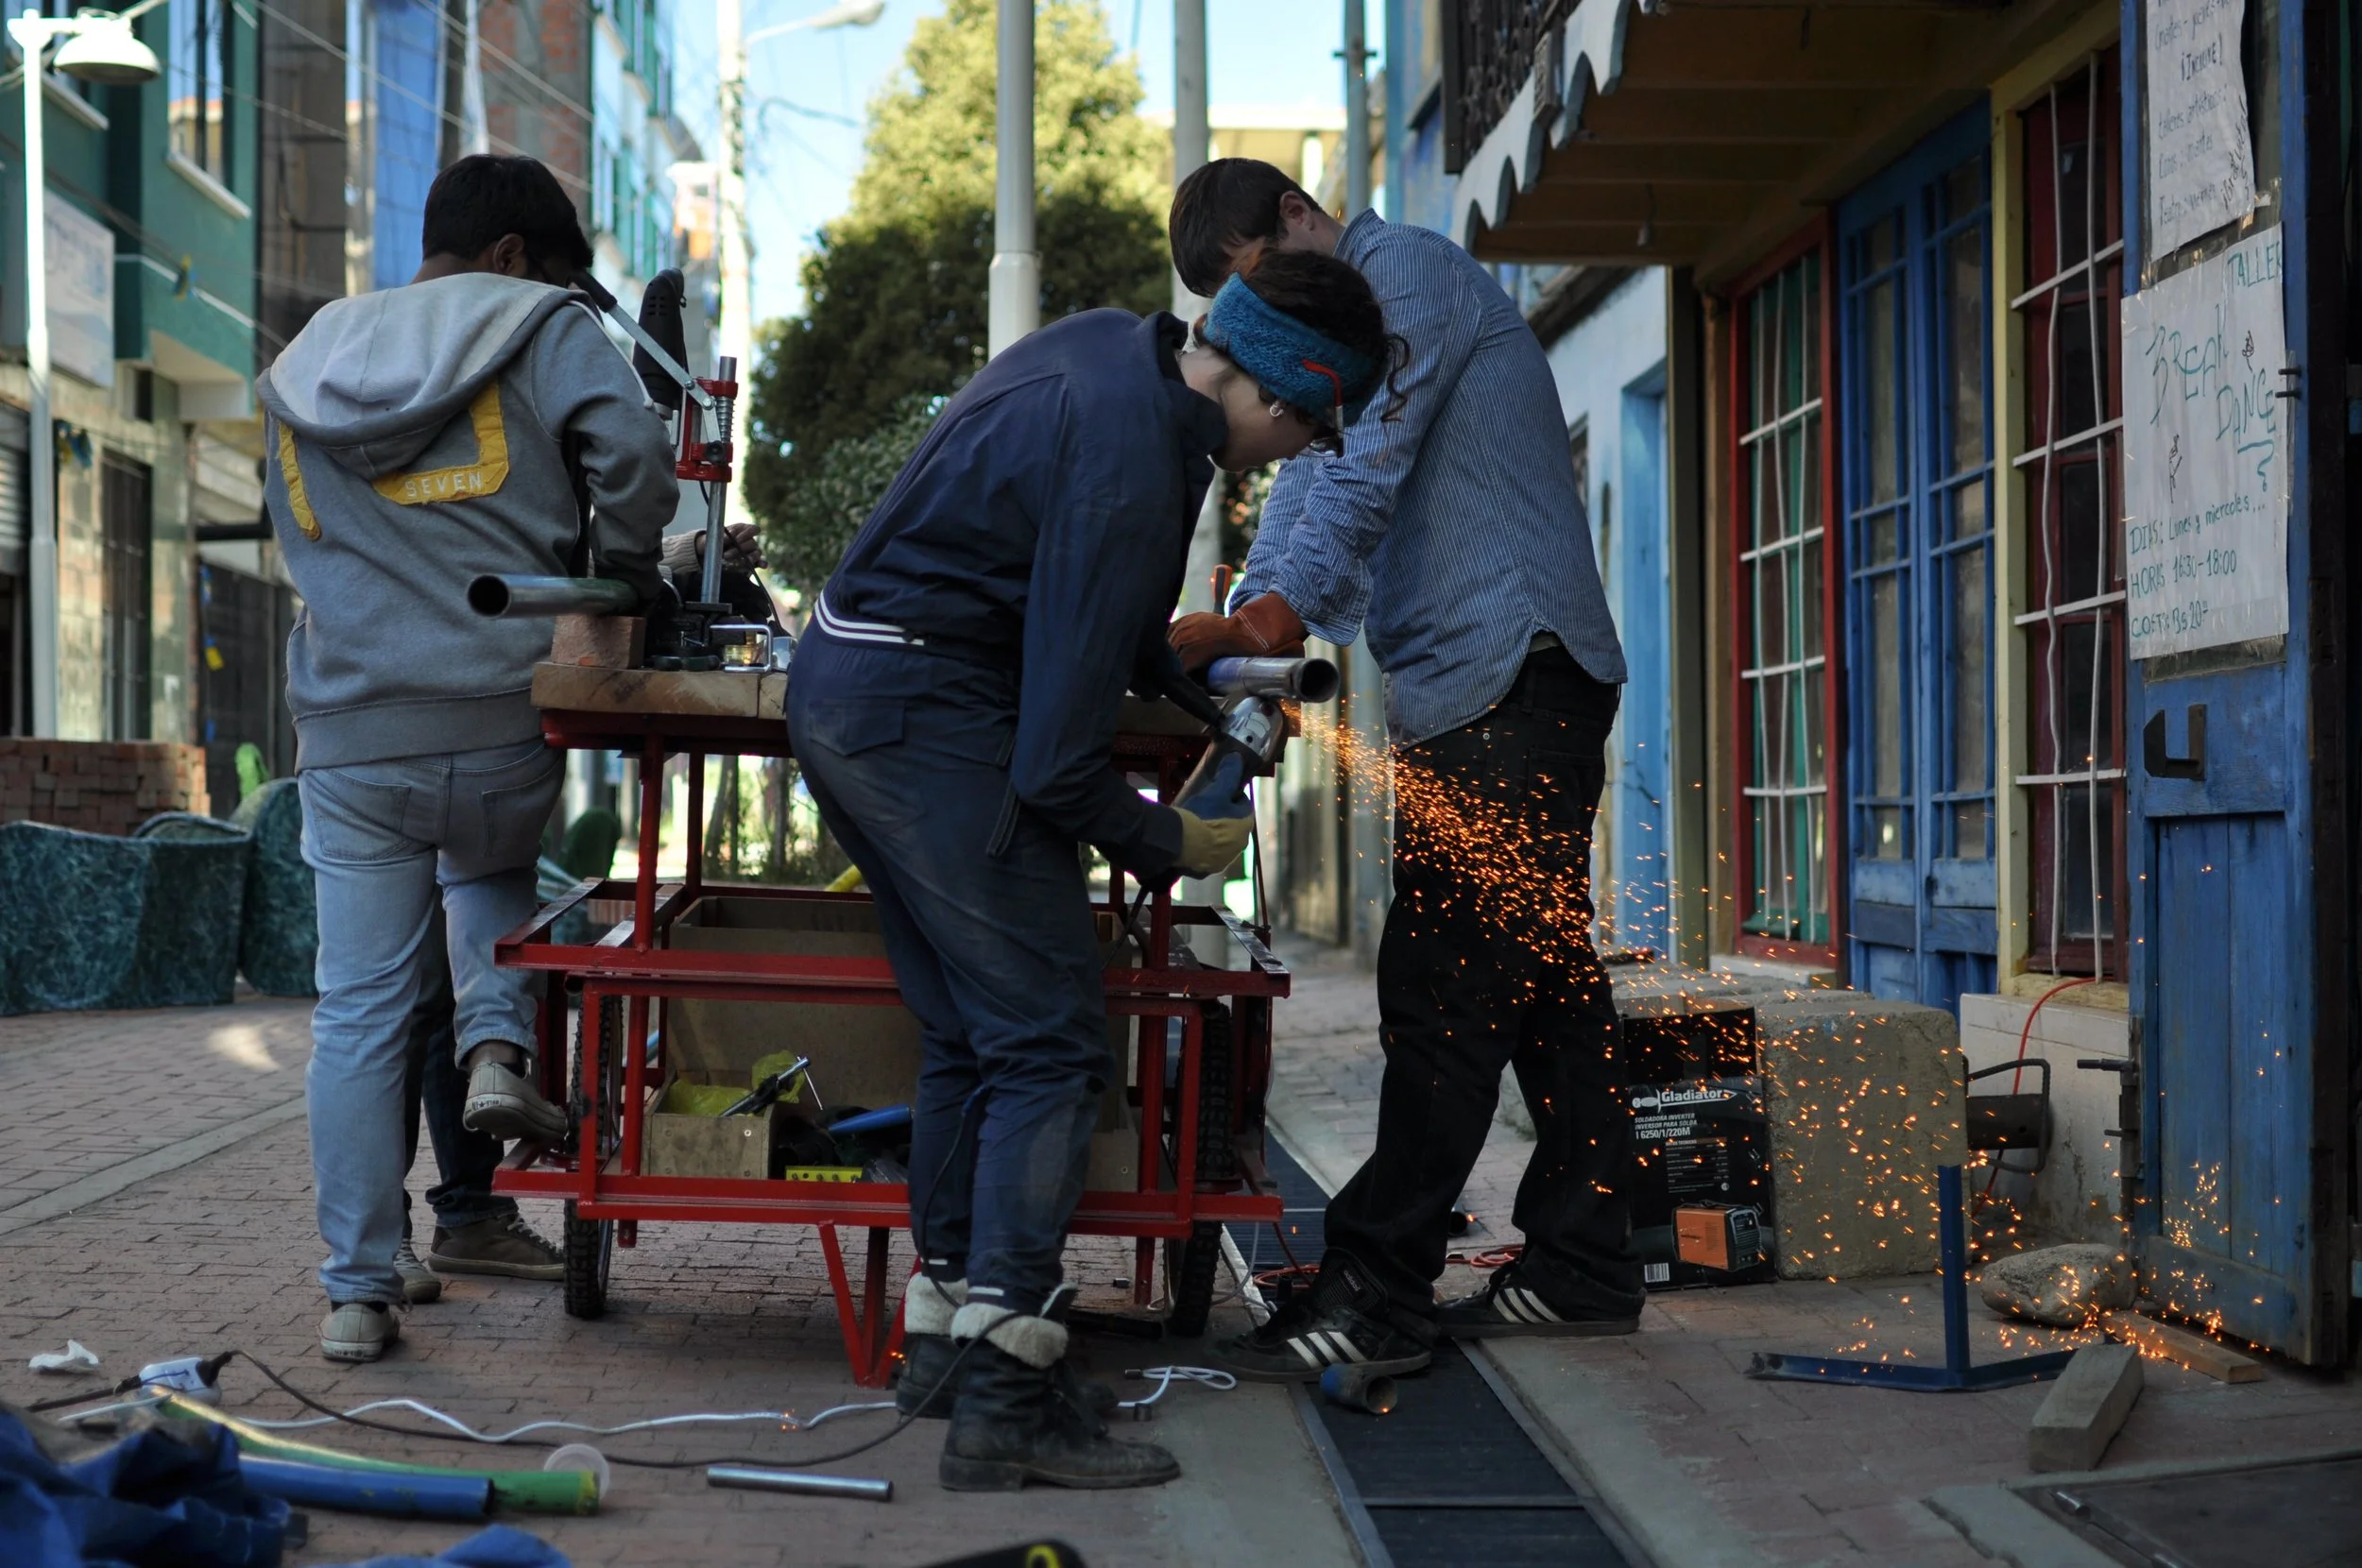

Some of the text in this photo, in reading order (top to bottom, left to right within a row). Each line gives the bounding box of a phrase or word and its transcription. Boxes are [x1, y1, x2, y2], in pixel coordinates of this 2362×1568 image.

[2228, 241, 2282, 294] TALLER
[2216, 367, 2276, 445] DANCE
[404, 470, 482, 499] SEVEN
[1661, 1088, 1722, 1103] Gladiator
[1640, 1127, 1690, 1139] 6250/1/220M
